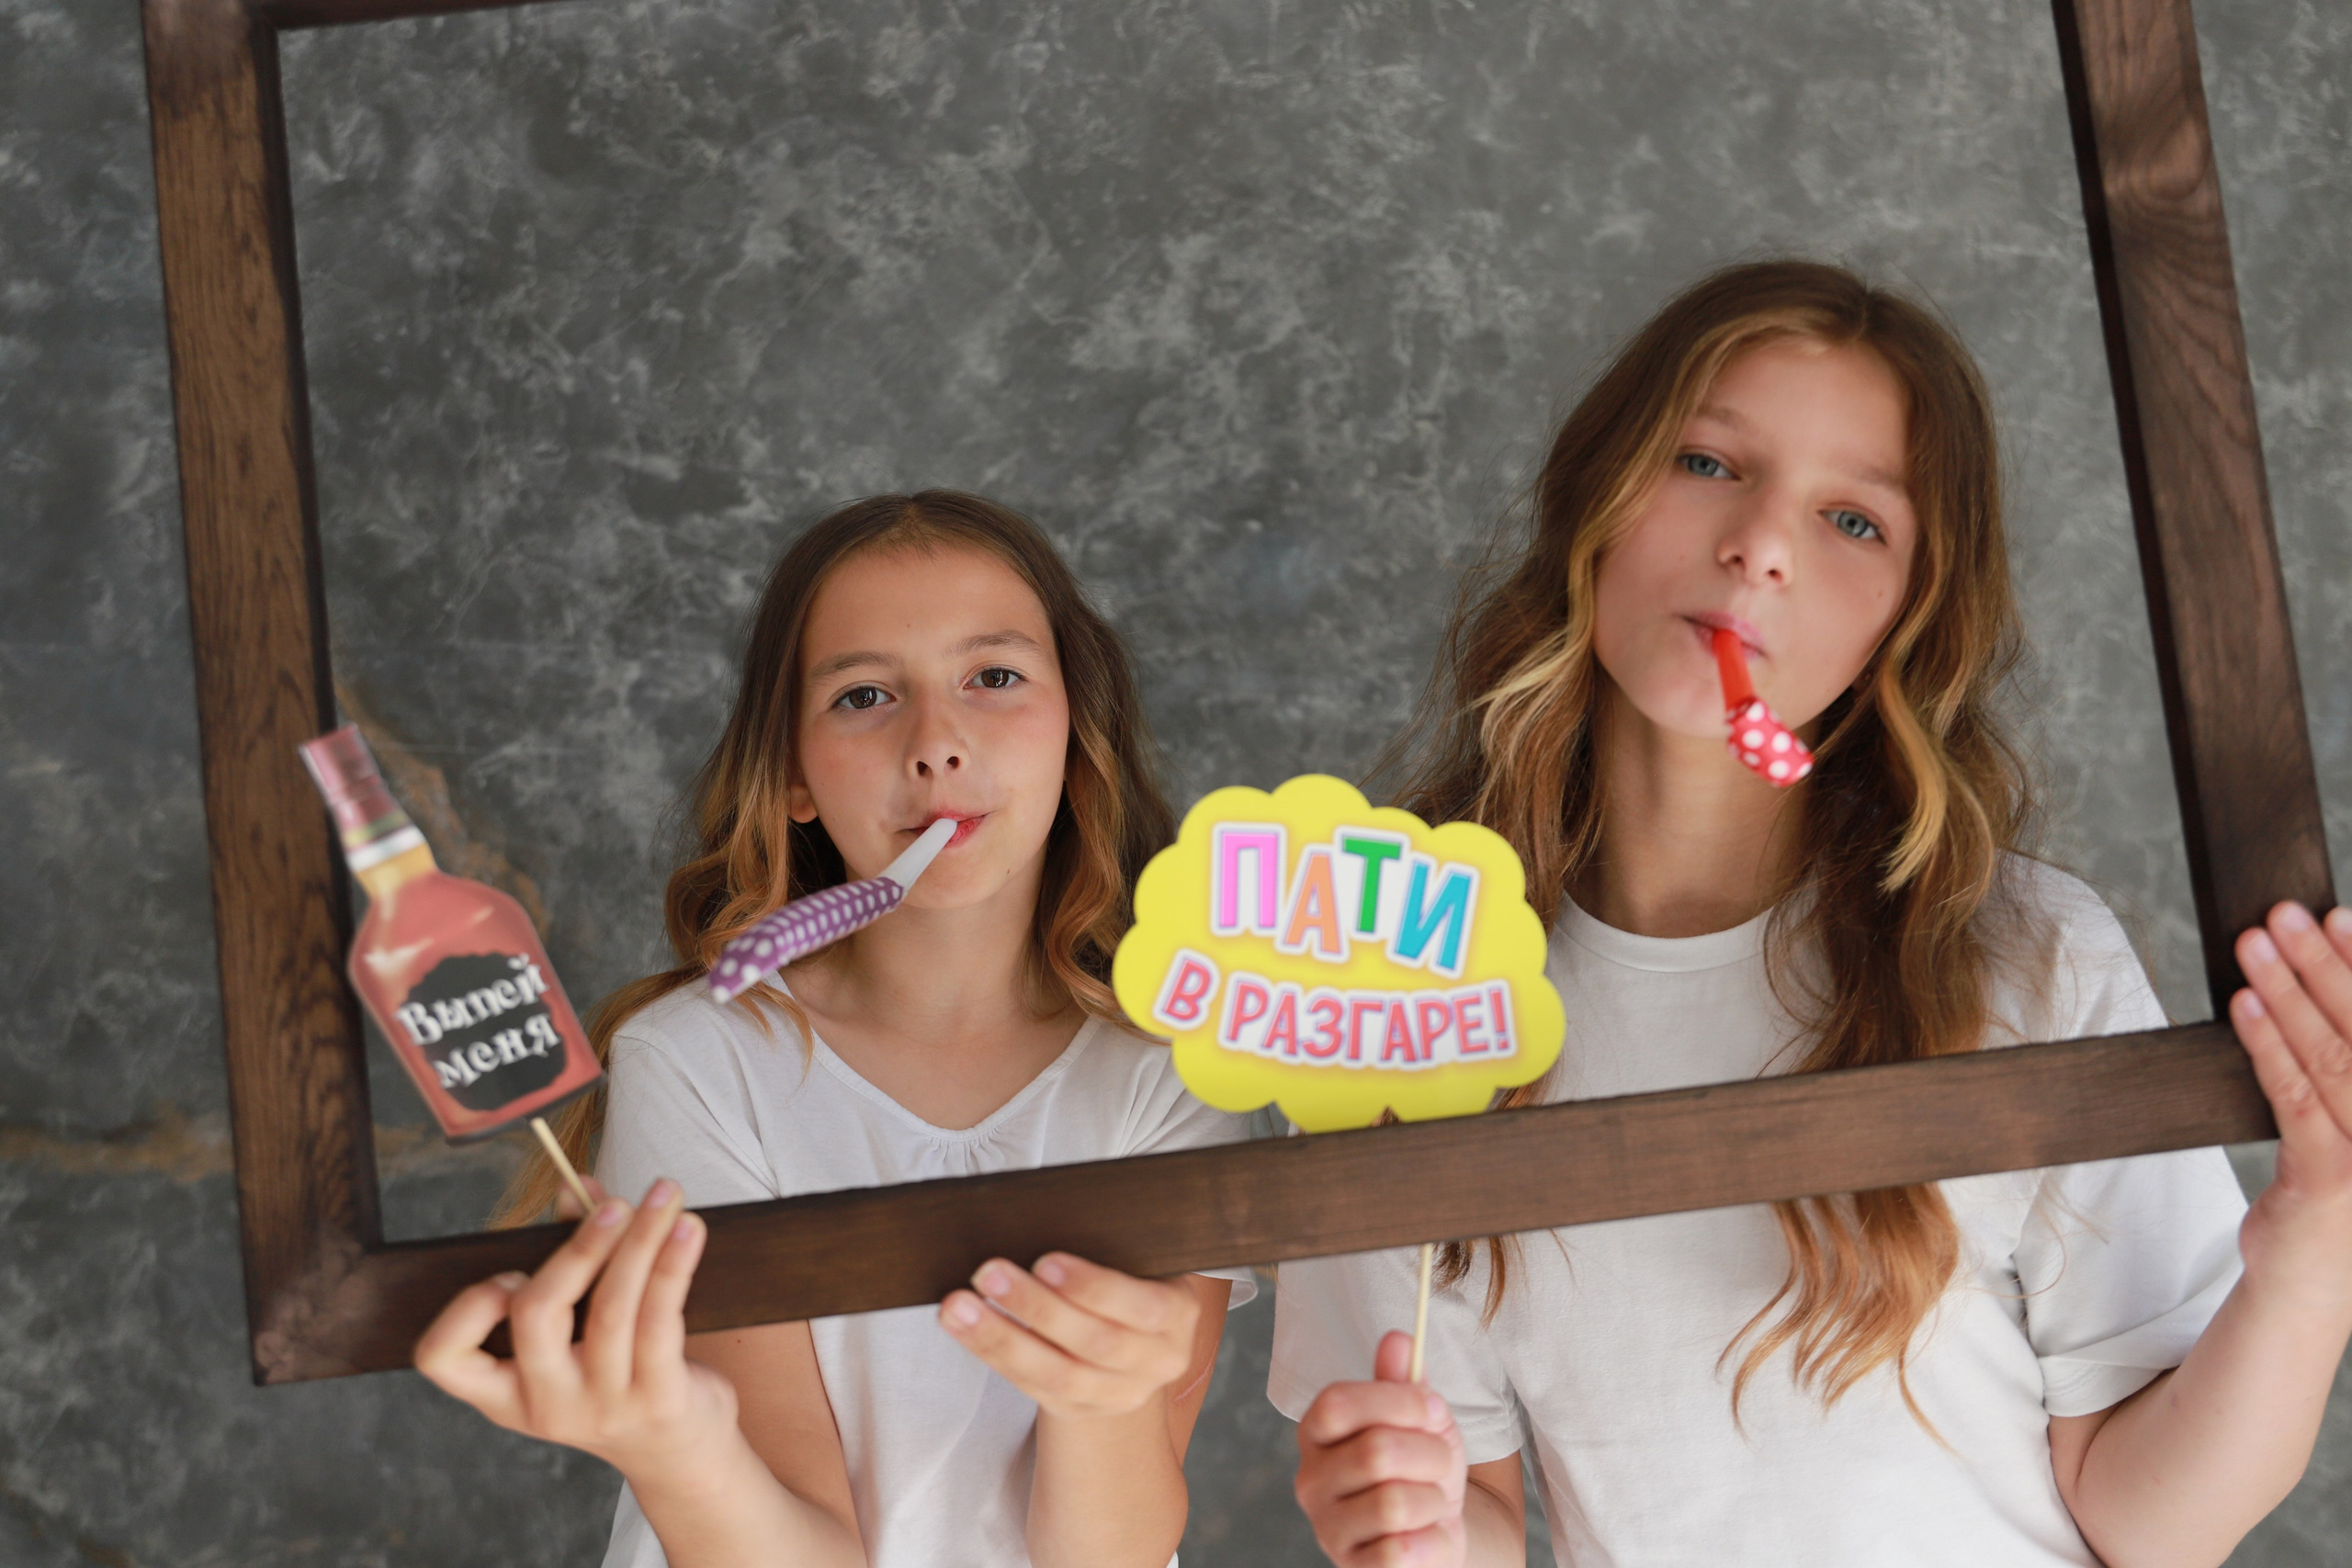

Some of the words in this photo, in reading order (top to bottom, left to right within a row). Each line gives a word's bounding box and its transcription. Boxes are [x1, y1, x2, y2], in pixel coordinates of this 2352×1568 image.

[1217, 829, 1472, 971] ПАТИ
[394, 953, 548, 1046] Выпей
[1162, 957, 1212, 1021] В
[1226, 980, 1510, 1063] РАЗГАРЕ!
[433, 1012, 560, 1089] меня
